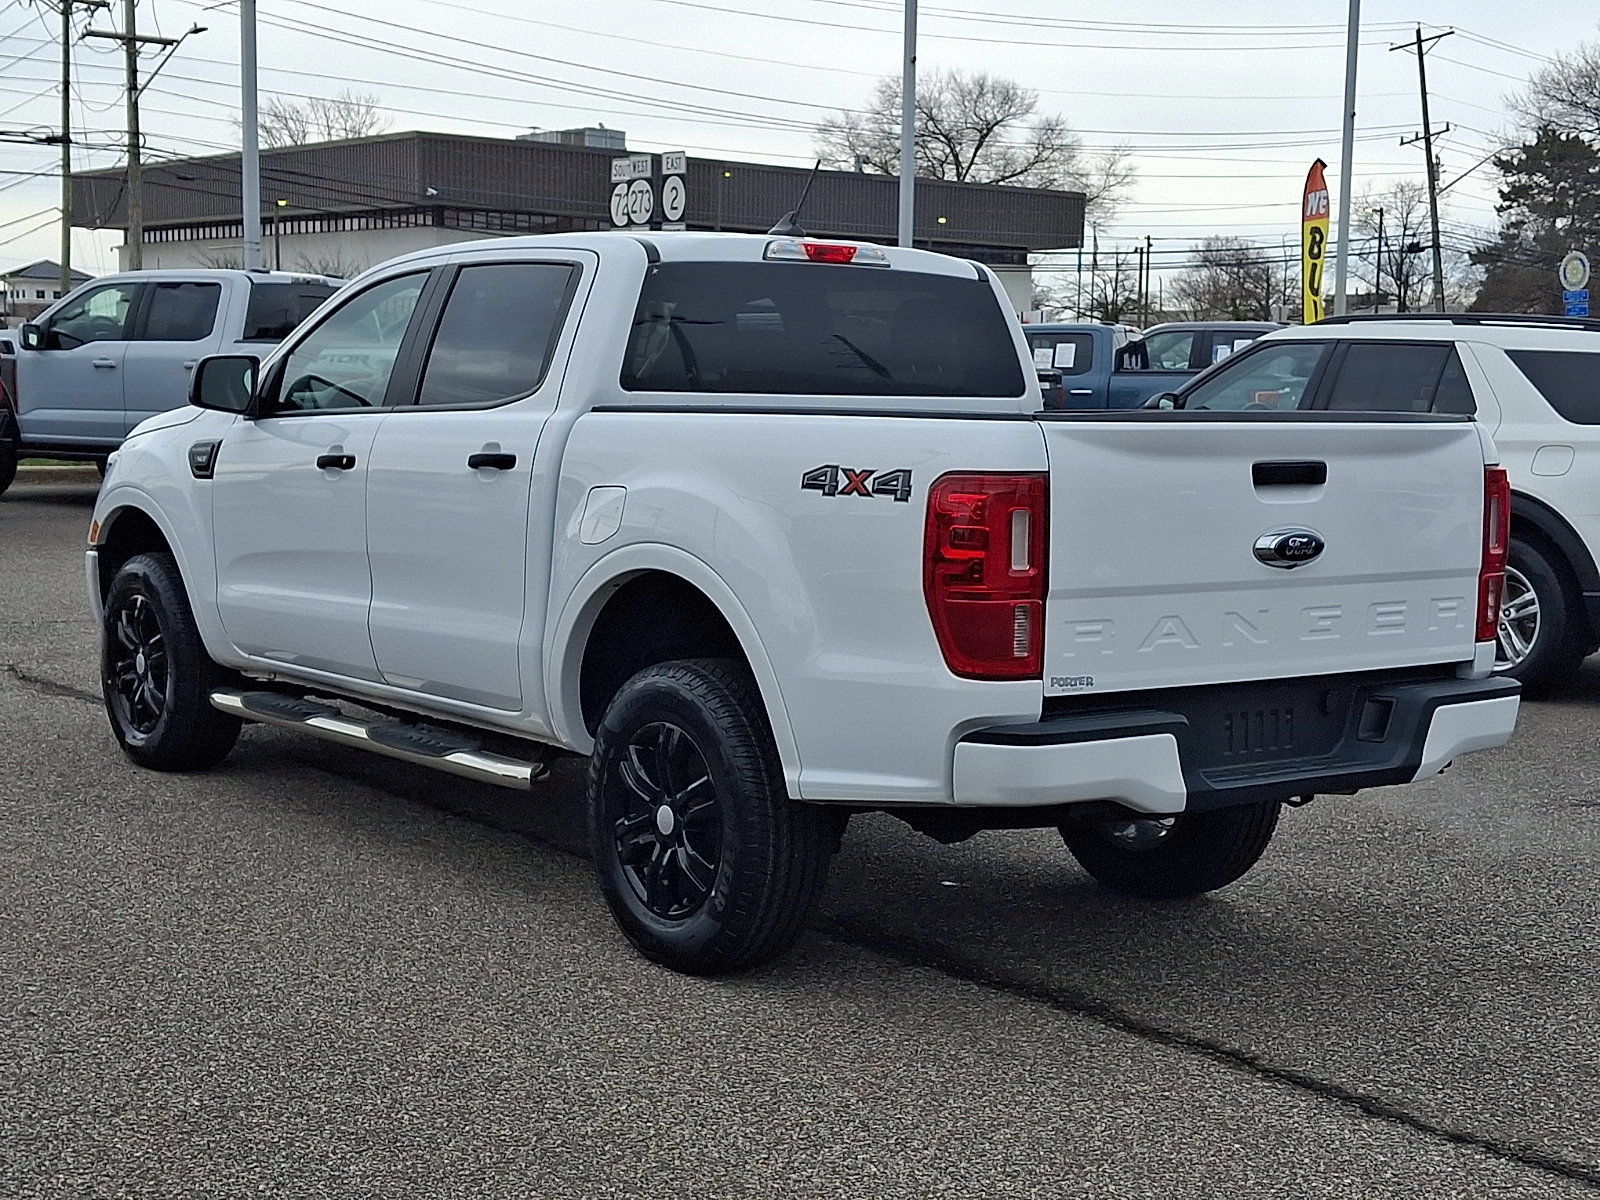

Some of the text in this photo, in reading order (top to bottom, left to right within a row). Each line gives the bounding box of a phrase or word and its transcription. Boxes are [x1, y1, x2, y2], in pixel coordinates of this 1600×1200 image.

[613, 163, 631, 177] SOUT
[632, 160, 648, 174] WEST
[666, 157, 682, 170] EAST
[631, 189, 651, 214] 273
[670, 186, 679, 210] 2
[1285, 537, 1316, 556] Ford
[1063, 596, 1466, 658] RANGER
[1050, 676, 1095, 688] PORTER
